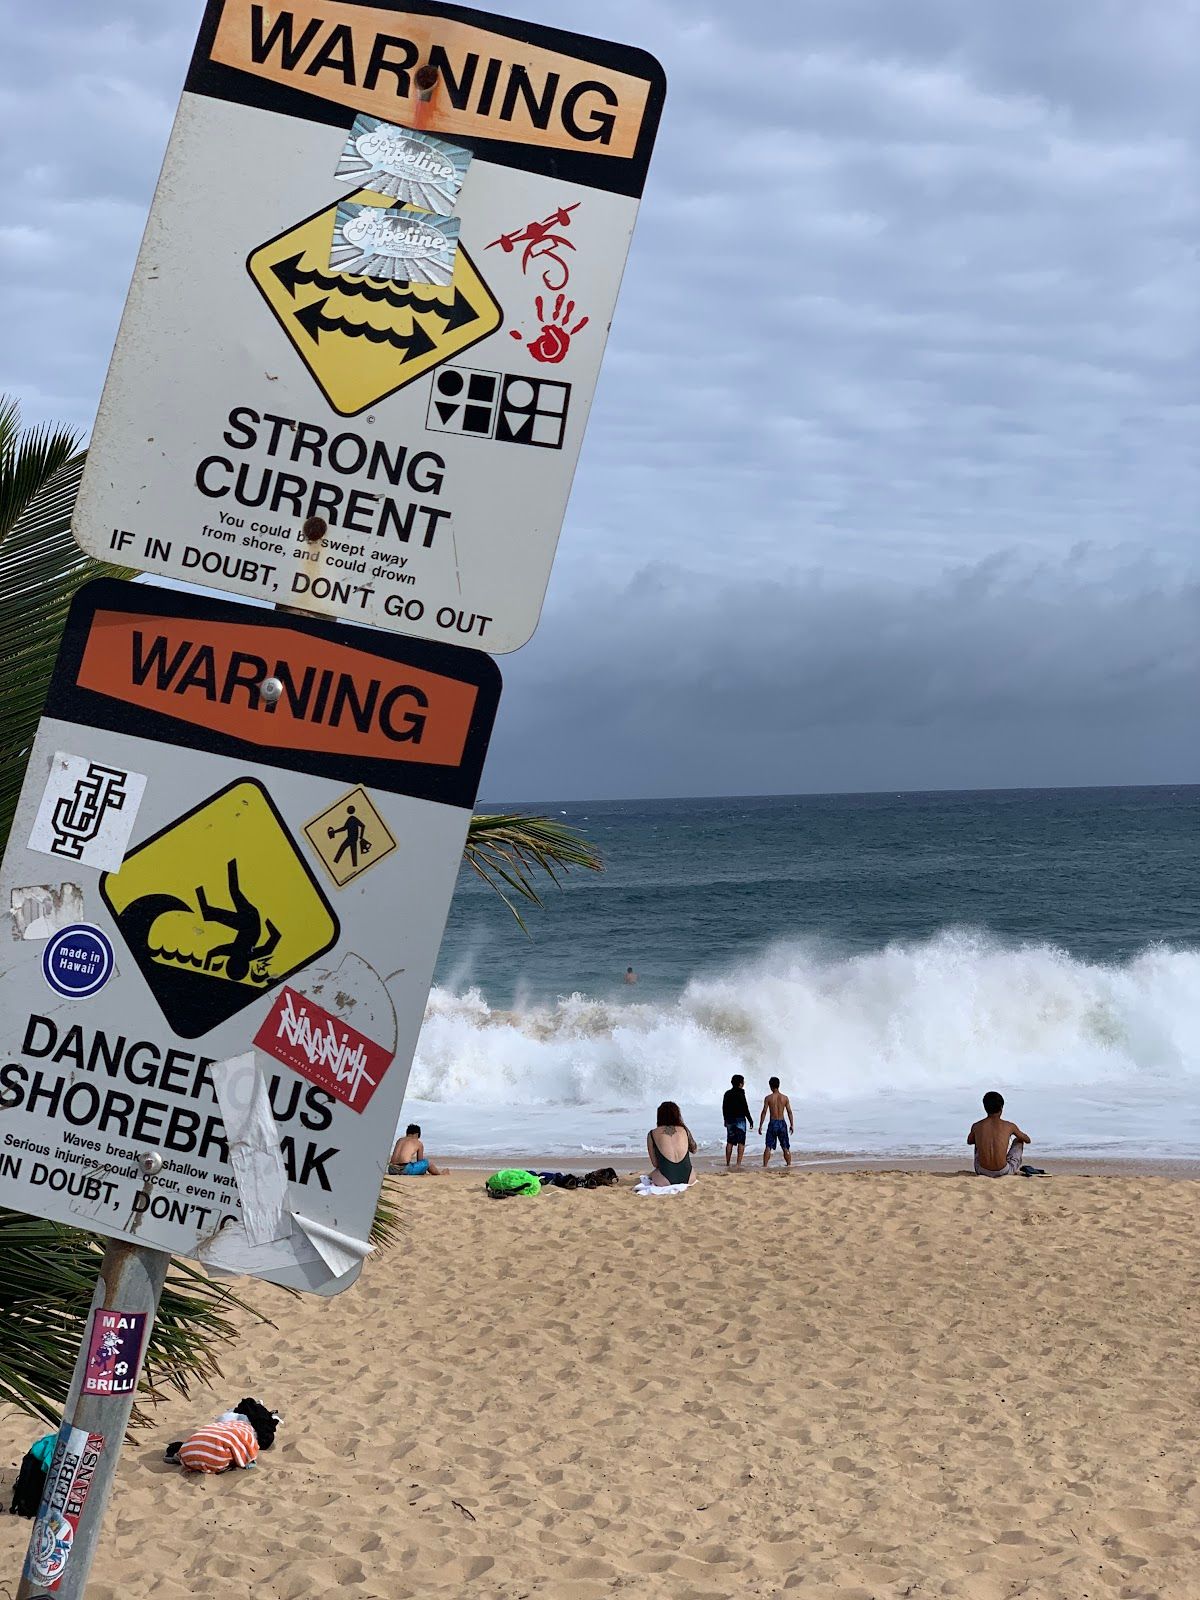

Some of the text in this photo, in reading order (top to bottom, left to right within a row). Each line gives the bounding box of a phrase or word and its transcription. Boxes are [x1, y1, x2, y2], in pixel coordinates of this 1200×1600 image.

[249, 4, 619, 145] WARNING
[359, 135, 455, 178] Pipeline
[348, 219, 445, 250] Pipeline
[223, 406, 446, 495] STRONG
[195, 455, 451, 548] CURRENT
[202, 525, 416, 585] from shore, and could drown
[219, 511, 244, 528] You
[250, 522, 291, 539] could
[321, 538, 365, 557] swept
[371, 549, 408, 568] away
[109, 529, 493, 637] IF IN DOUBT, DON'T GO OUT
[131, 631, 429, 744] WARNING
[59, 958, 95, 975] Hawaii
[60, 947, 100, 963] made in
[0, 1063, 340, 1192] SHOREBRAK
[63, 1131, 102, 1151] Waves
[106, 1143, 141, 1162] break
[162, 1159, 208, 1179] shallow
[4, 1134, 50, 1156] Serious
[54, 1147, 99, 1169] injuries
[104, 1163, 138, 1179] could
[142, 1174, 180, 1193] occur,
[186, 1184, 215, 1200] even
[219, 1191, 231, 1204] in
[29, 1163, 120, 1211] DOUBT,
[131, 1190, 212, 1230] DON'T
[102, 1316, 136, 1330] MAI
[86, 1378, 134, 1392] BRILLI
[51, 1452, 80, 1514] LEBE
[66, 1433, 104, 1517] HANSA
